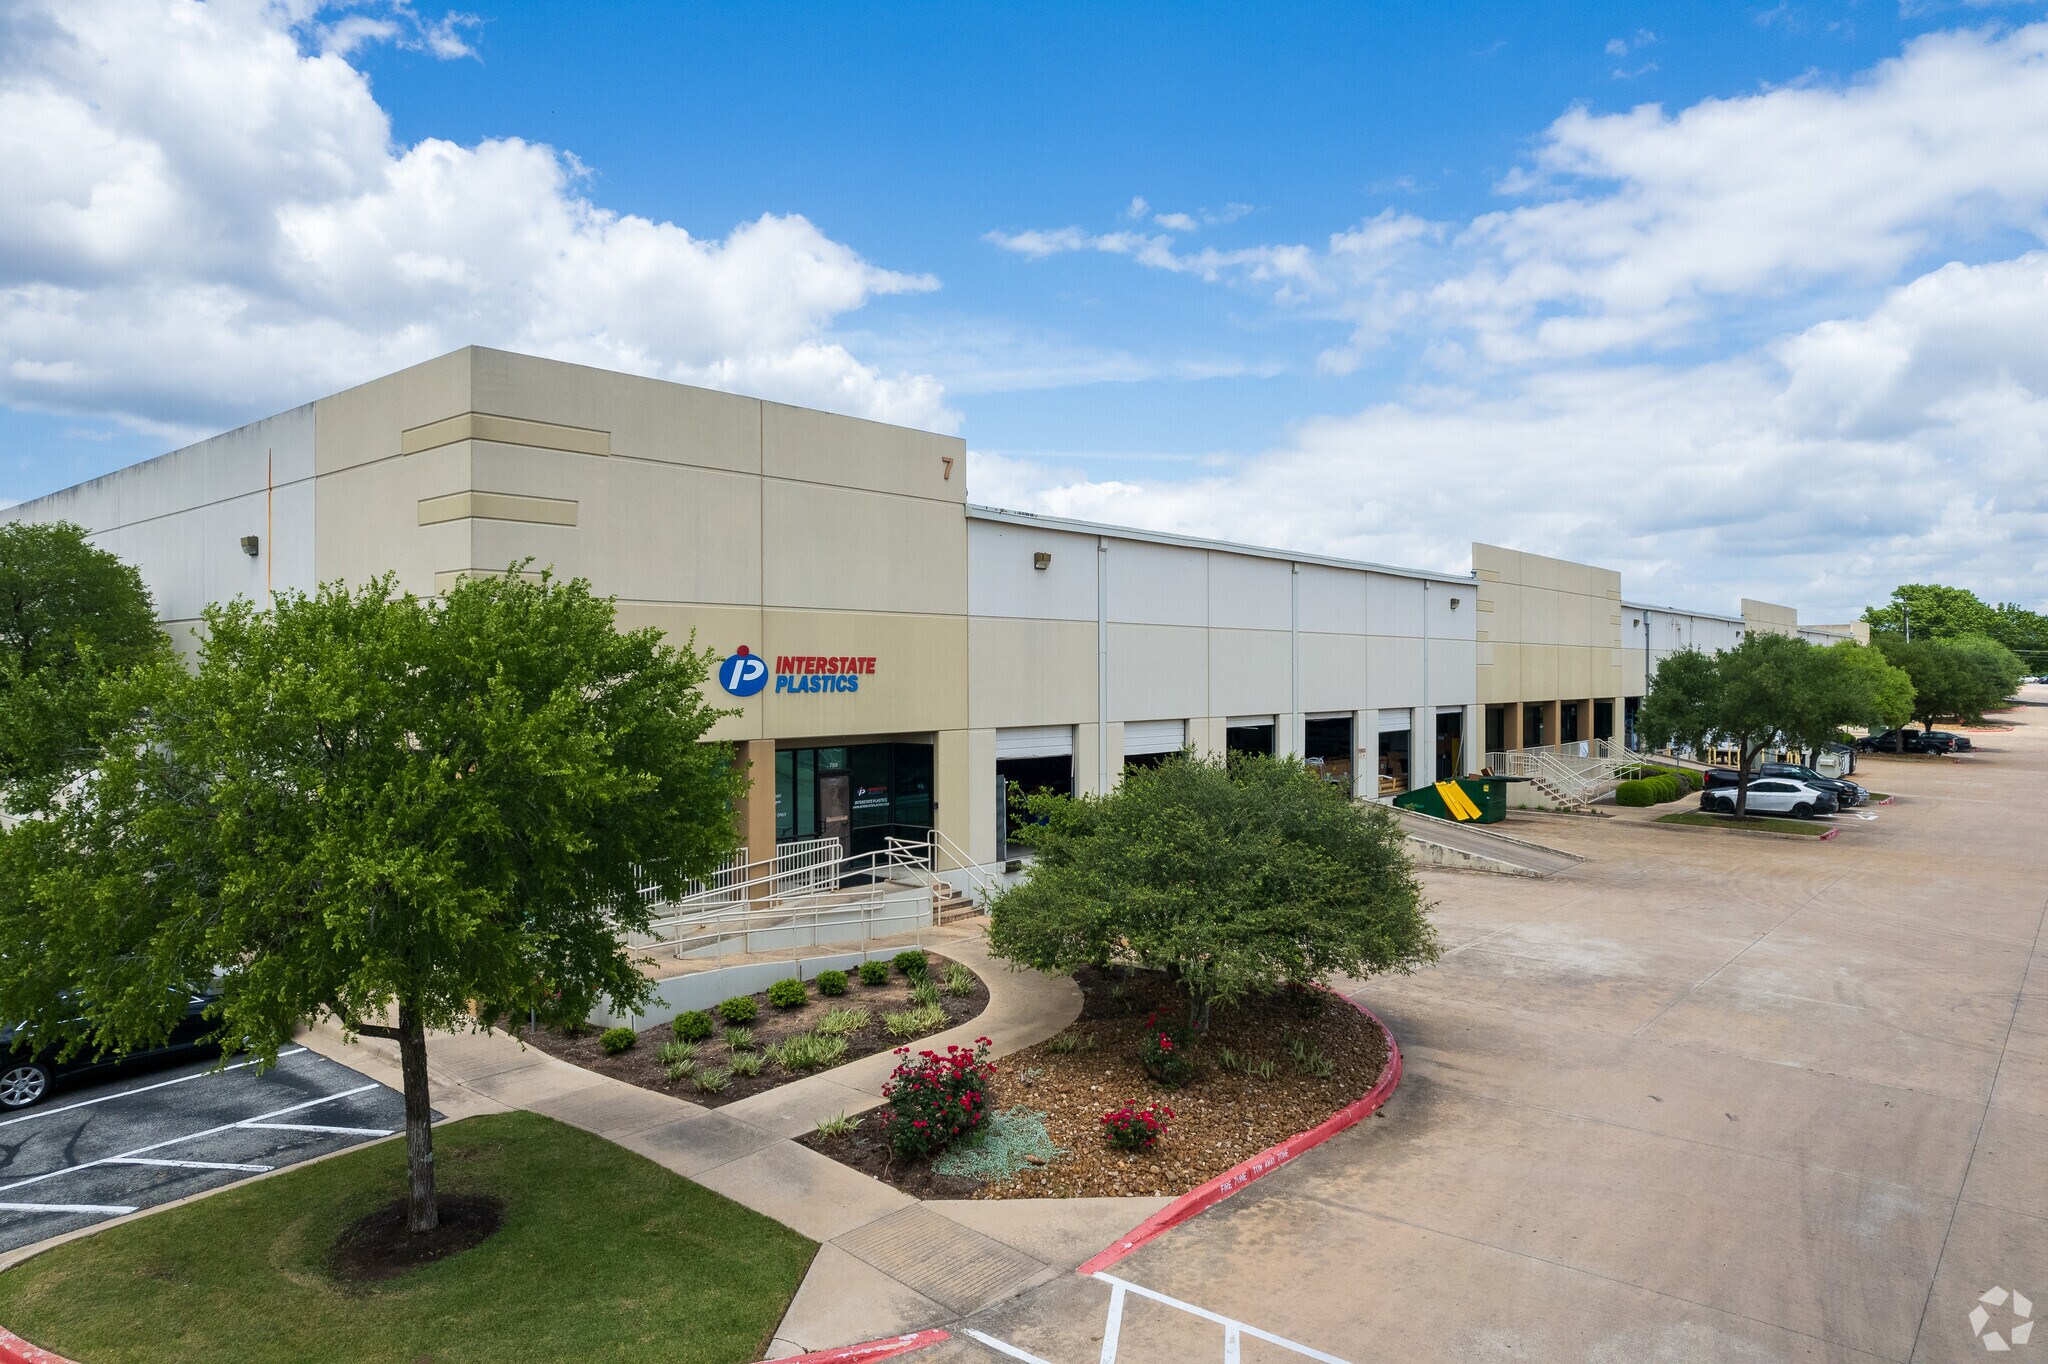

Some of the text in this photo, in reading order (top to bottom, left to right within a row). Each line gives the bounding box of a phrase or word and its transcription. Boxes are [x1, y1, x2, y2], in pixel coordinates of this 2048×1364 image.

[942, 457, 954, 480] 7
[775, 656, 877, 674] INTERSTATE
[775, 675, 859, 693] PLASTICS
[1220, 1180, 1233, 1194] FIRE
[1252, 1163, 1263, 1174] TOW
[1264, 1155, 1275, 1168] AWAY
